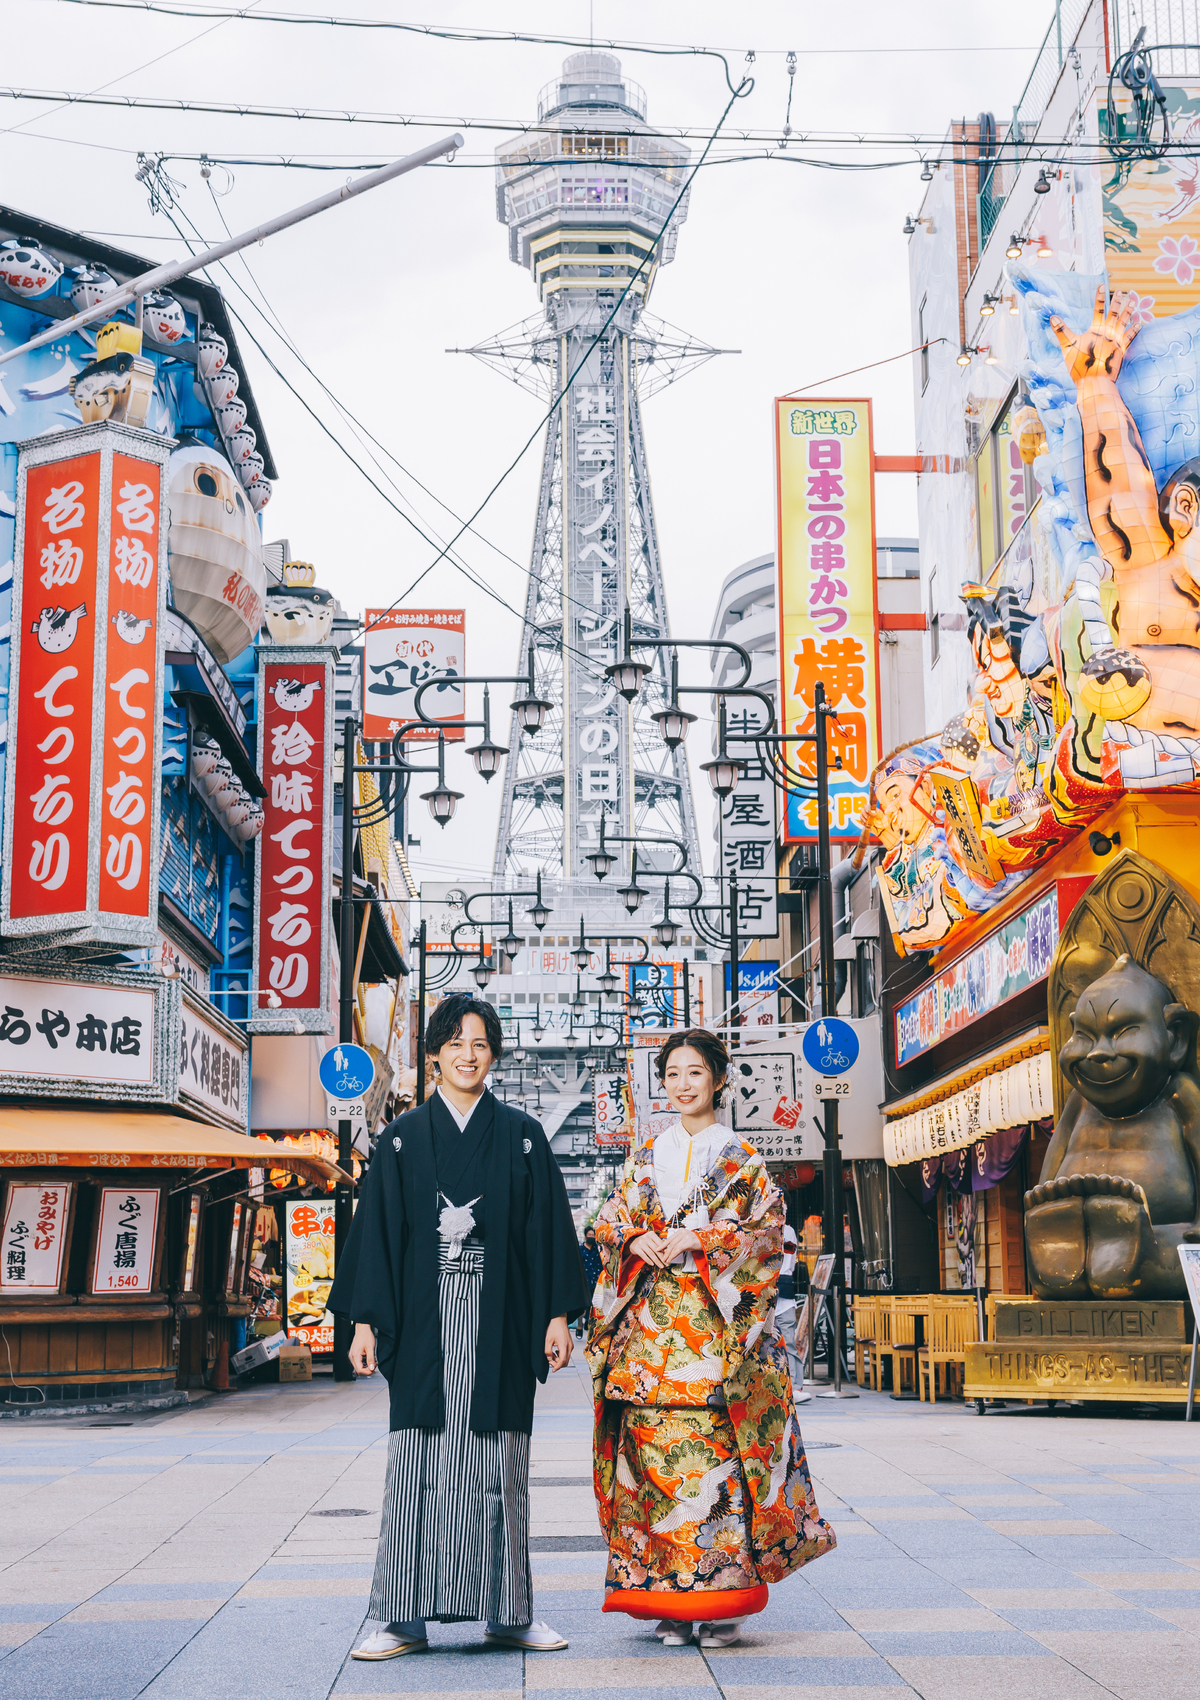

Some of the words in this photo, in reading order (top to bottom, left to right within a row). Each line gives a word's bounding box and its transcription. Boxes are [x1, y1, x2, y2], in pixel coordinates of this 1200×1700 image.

[791, 410, 857, 435] 新世界
[40, 480, 84, 590] 名物
[114, 480, 155, 589] 名物
[806, 439, 848, 633] 日本一の串かつ
[368, 659, 461, 695] エビス
[794, 637, 867, 783] 横綱
[747, 1136, 803, 1145] カウンター席
[757, 1147, 803, 1157] 数あります
[34, 1191, 59, 1251] おみやげ
[113, 1195, 141, 1268] ふぐ唐揚
[6, 1220, 29, 1281] ふぐ料理
[108, 1275, 139, 1288] 1,540
[1018, 1310, 1158, 1337] BILLIKEN
[985, 1352, 1191, 1387] THINGS-AS-THEY
